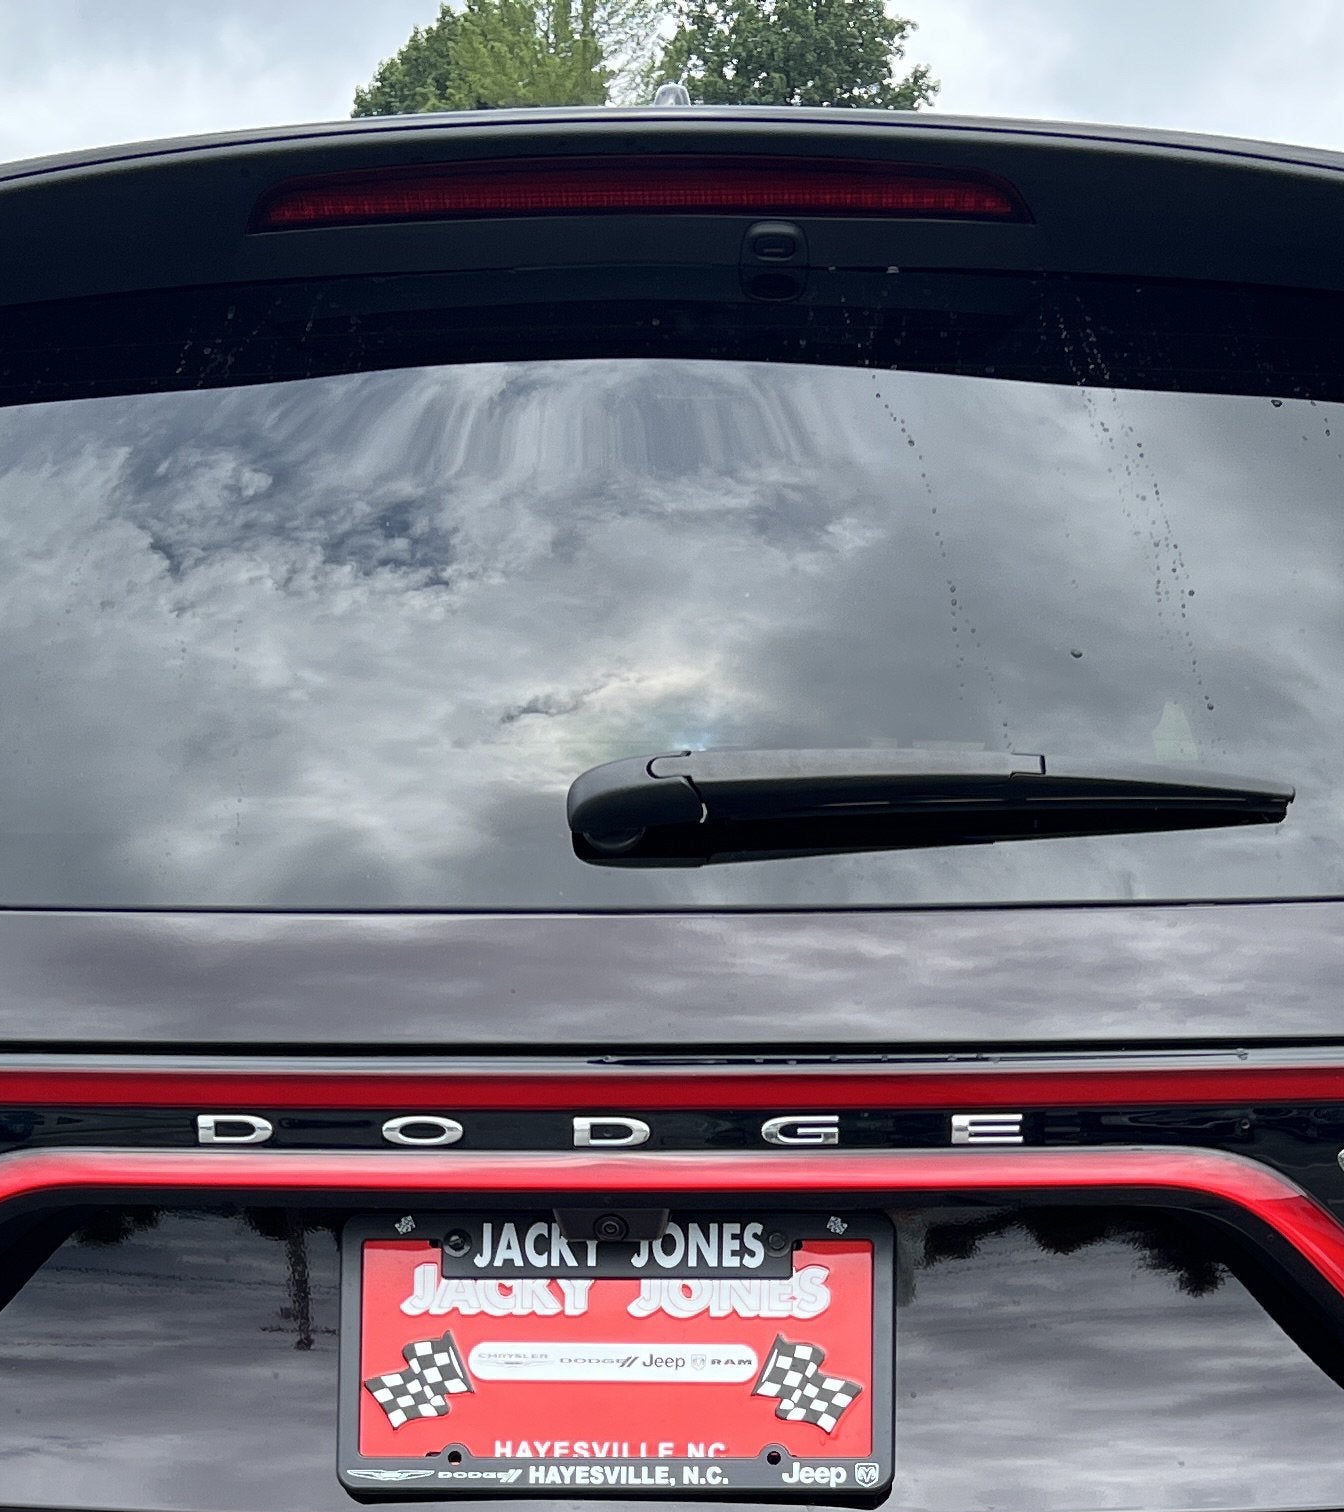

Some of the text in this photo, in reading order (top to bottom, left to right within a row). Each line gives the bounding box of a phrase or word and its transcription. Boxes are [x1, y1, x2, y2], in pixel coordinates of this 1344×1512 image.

[197, 1114, 1024, 1146] DODGE
[474, 1222, 765, 1268] JACKY JONES
[400, 1263, 832, 1319] JACKY JONES
[478, 1352, 549, 1360] CHRYSLER
[559, 1357, 625, 1365] DODGE
[642, 1354, 685, 1371] Jeep
[438, 1471, 509, 1479] DODGE
[528, 1466, 729, 1487] HAYESVILLE, N.C.
[782, 1462, 847, 1488] Jeep
